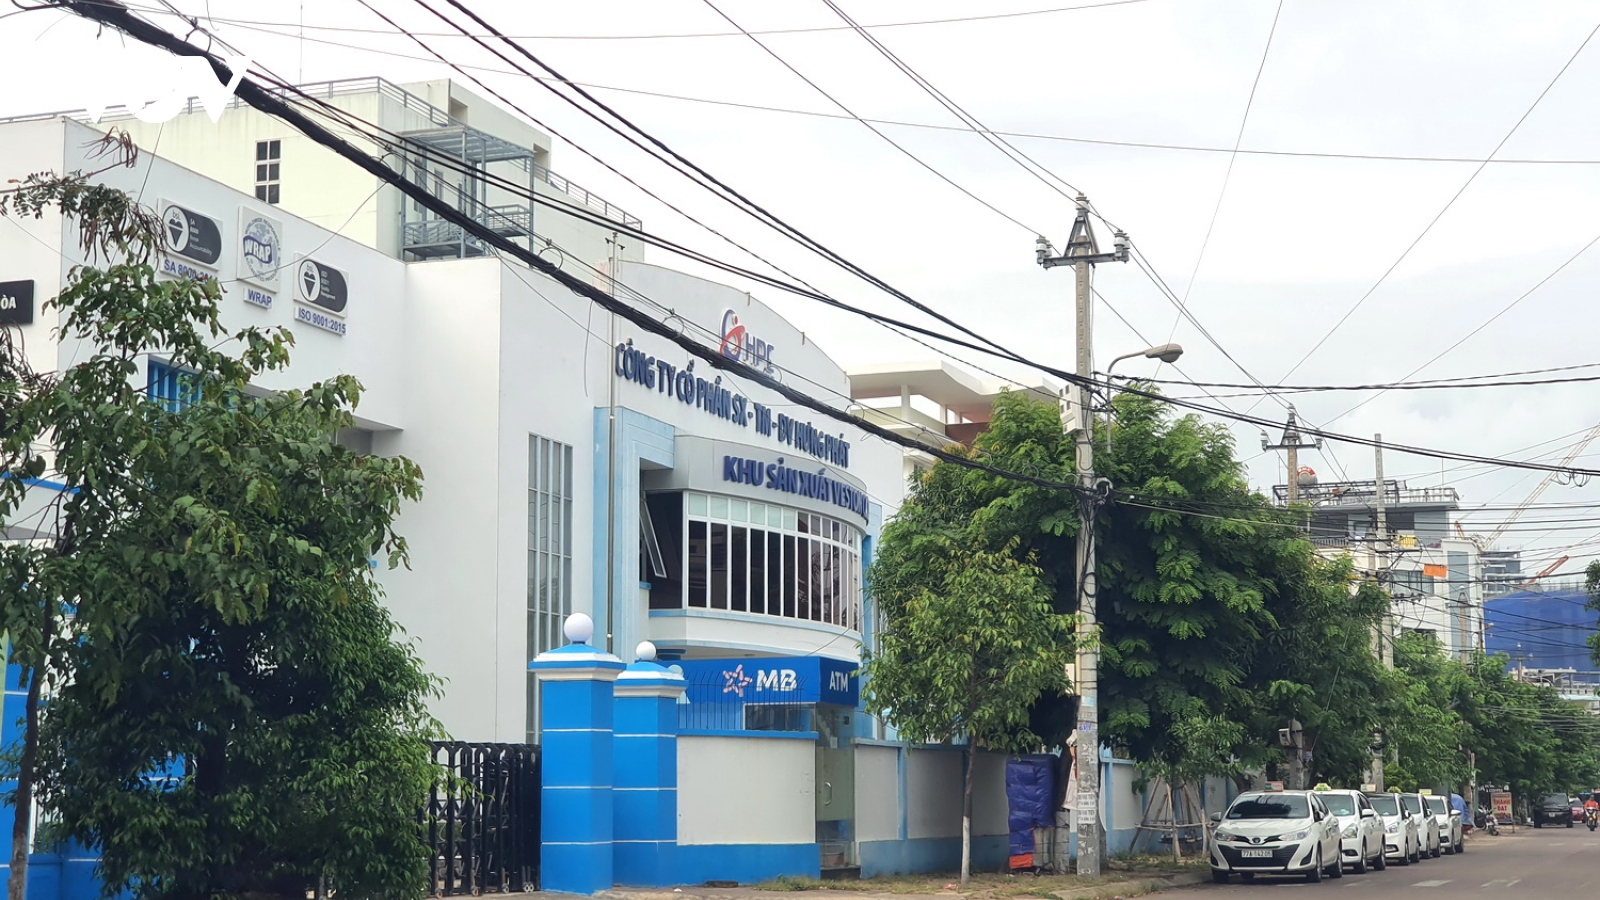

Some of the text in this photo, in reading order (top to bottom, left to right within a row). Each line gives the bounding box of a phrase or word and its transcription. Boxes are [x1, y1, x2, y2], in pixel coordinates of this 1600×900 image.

[244, 237, 272, 263] WRAP
[164, 259, 177, 274] SA
[247, 289, 272, 306] WRAP
[298, 306, 346, 334] ISO 9001:2015
[615, 338, 655, 389] CÔNG
[657, 359, 676, 397] TY
[676, 359, 695, 405] CỔ
[732, 393, 748, 427] SX
[825, 432, 850, 469] PHÁT
[723, 455, 765, 486] KHU
[766, 457, 798, 494] SẢN
[798, 468, 832, 502] XUẤT
[756, 669, 849, 692] MB ATM
